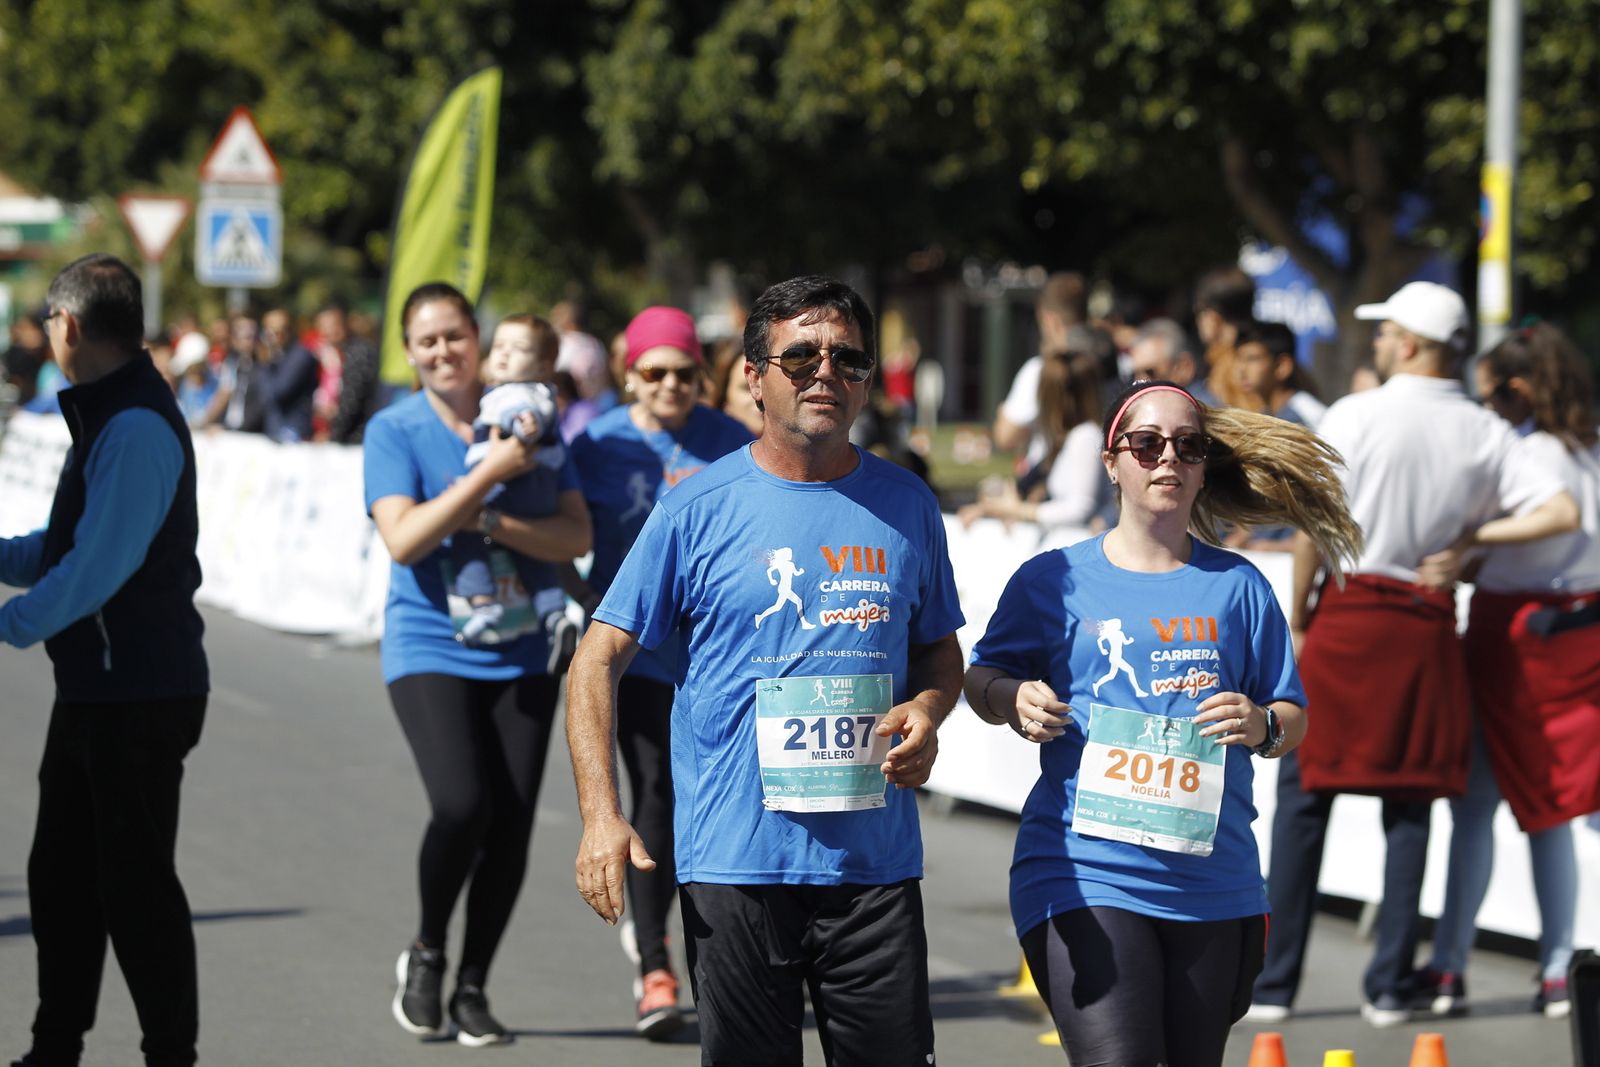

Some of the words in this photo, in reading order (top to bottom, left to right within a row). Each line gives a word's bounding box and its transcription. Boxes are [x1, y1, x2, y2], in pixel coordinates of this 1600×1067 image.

[820, 545, 887, 575] VIII
[820, 580, 891, 593] CARRERA
[821, 599, 890, 631] mujer
[1150, 617, 1218, 643] VIII
[763, 650, 811, 664] IGUALDAD
[1150, 649, 1220, 662] CARRERA
[830, 678, 853, 689] VIII
[1152, 668, 1220, 698] mujer
[783, 716, 876, 751] 2187
[811, 750, 855, 761] MELERO
[1104, 748, 1200, 793] 2018
[1131, 785, 1172, 799] NOELIA
